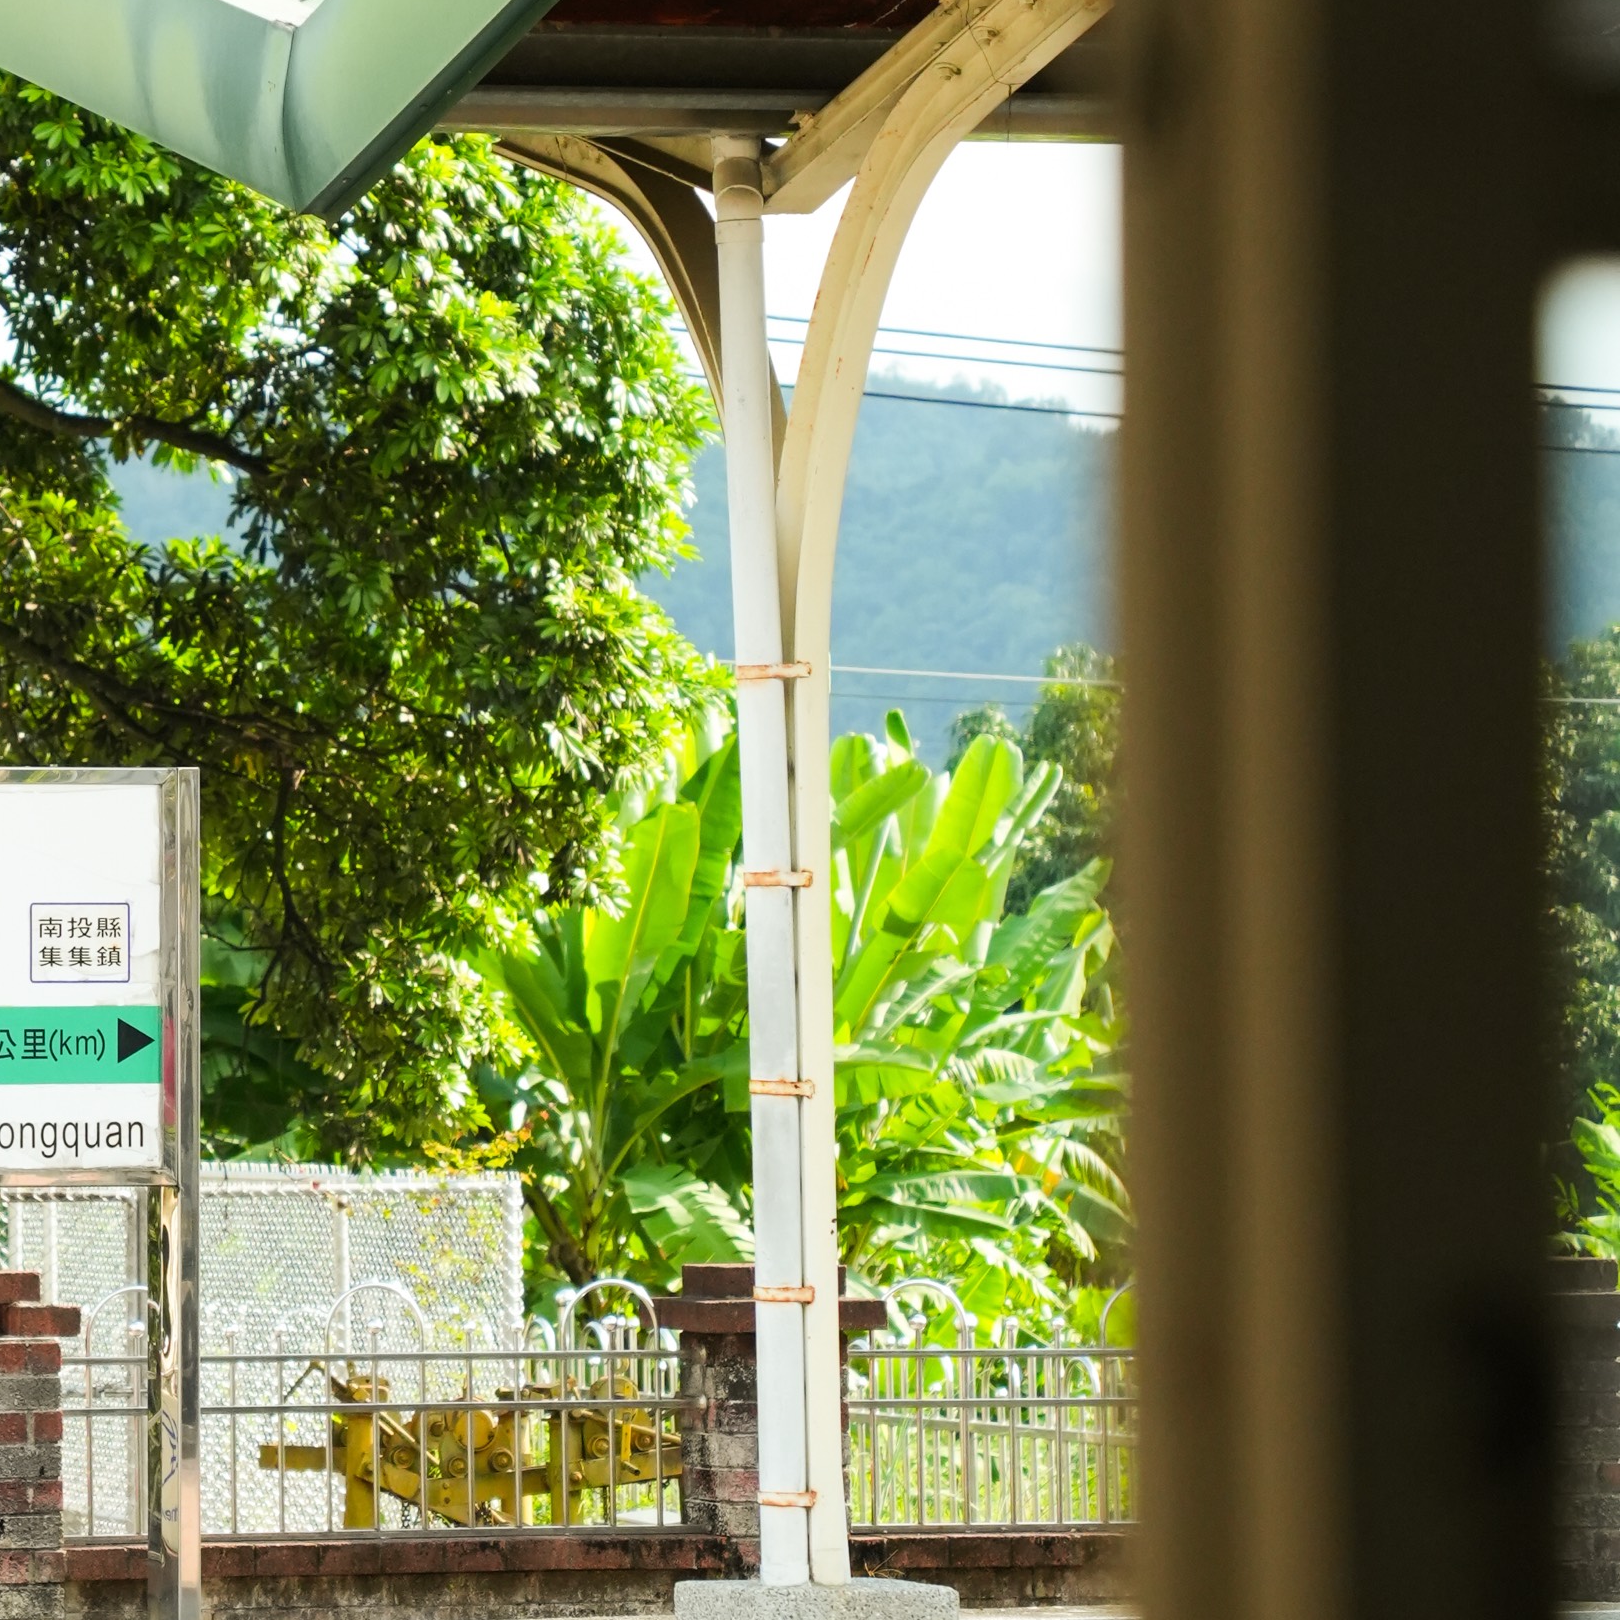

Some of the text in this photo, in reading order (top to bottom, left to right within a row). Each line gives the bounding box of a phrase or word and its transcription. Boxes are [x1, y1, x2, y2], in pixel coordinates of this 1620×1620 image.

[38, 916, 122, 939] 南投縣
[38, 945, 122, 967] 集集鎮
